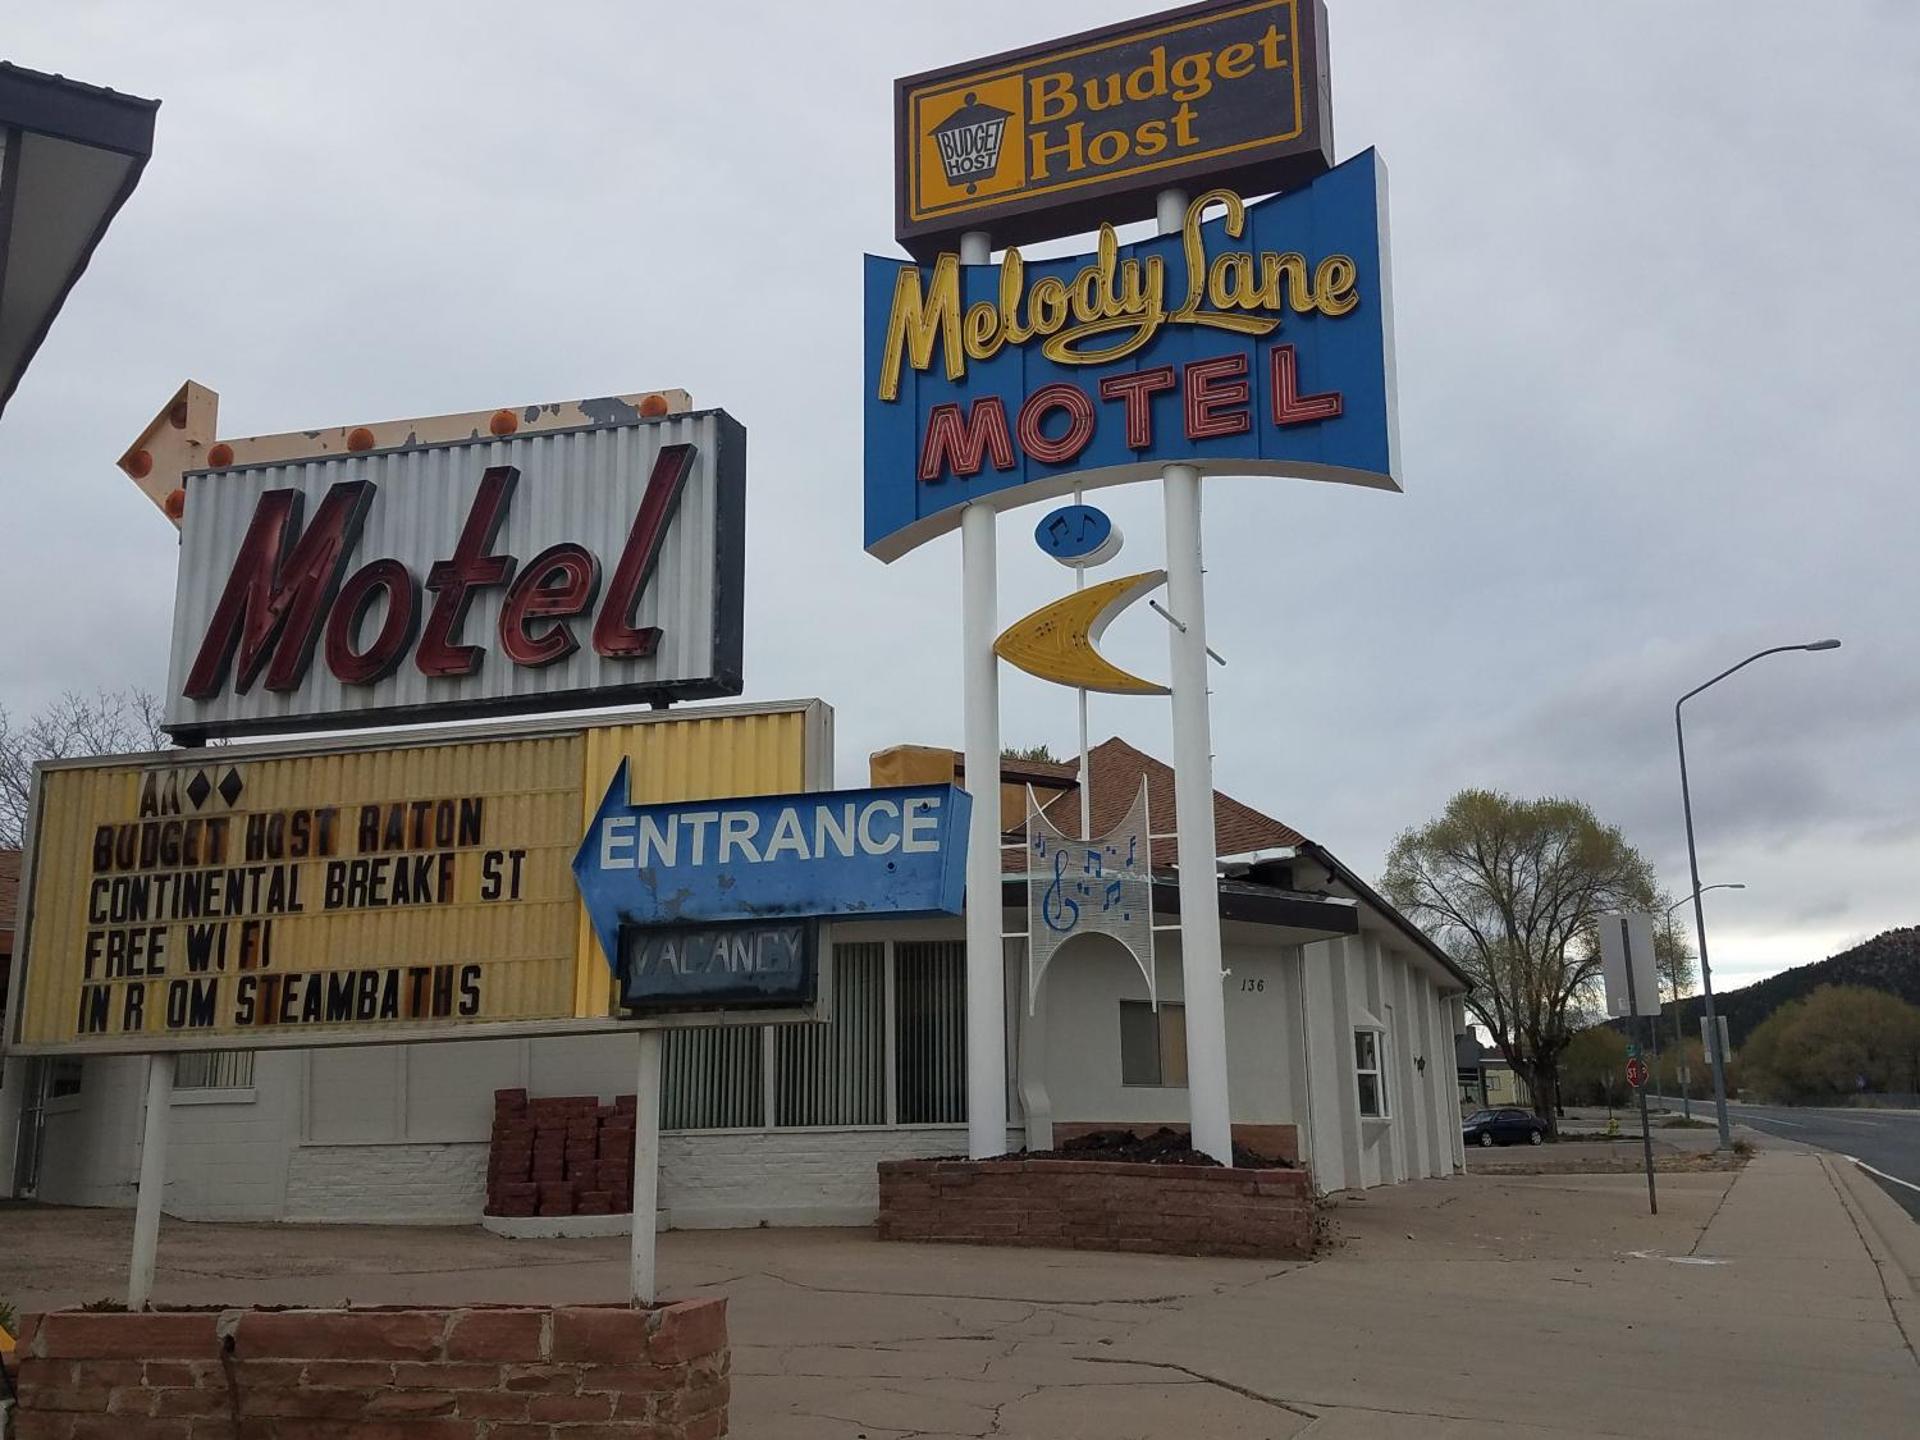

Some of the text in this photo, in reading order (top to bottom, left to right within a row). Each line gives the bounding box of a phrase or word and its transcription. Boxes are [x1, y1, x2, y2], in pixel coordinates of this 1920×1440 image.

[1028, 24, 1288, 126] Budget
[940, 120, 1003, 161] BUDGET
[947, 152, 996, 175] HOST
[1029, 103, 1200, 181] Host
[878, 188, 1360, 402] Melody Lane
[917, 342, 1343, 482] MOTEL
[183, 443, 698, 699] Motel
[93, 797, 483, 873] BUDGET HOST RATON
[600, 797, 941, 870] ENTRANCE
[89, 864, 303, 925] CONTINENTAL
[84, 926, 167, 979] FREE
[630, 927, 801, 976] VACANCY
[1240, 979, 1265, 992] 136
[78, 984, 111, 1033] IN
[235, 965, 481, 1025] STEAMBATHS
